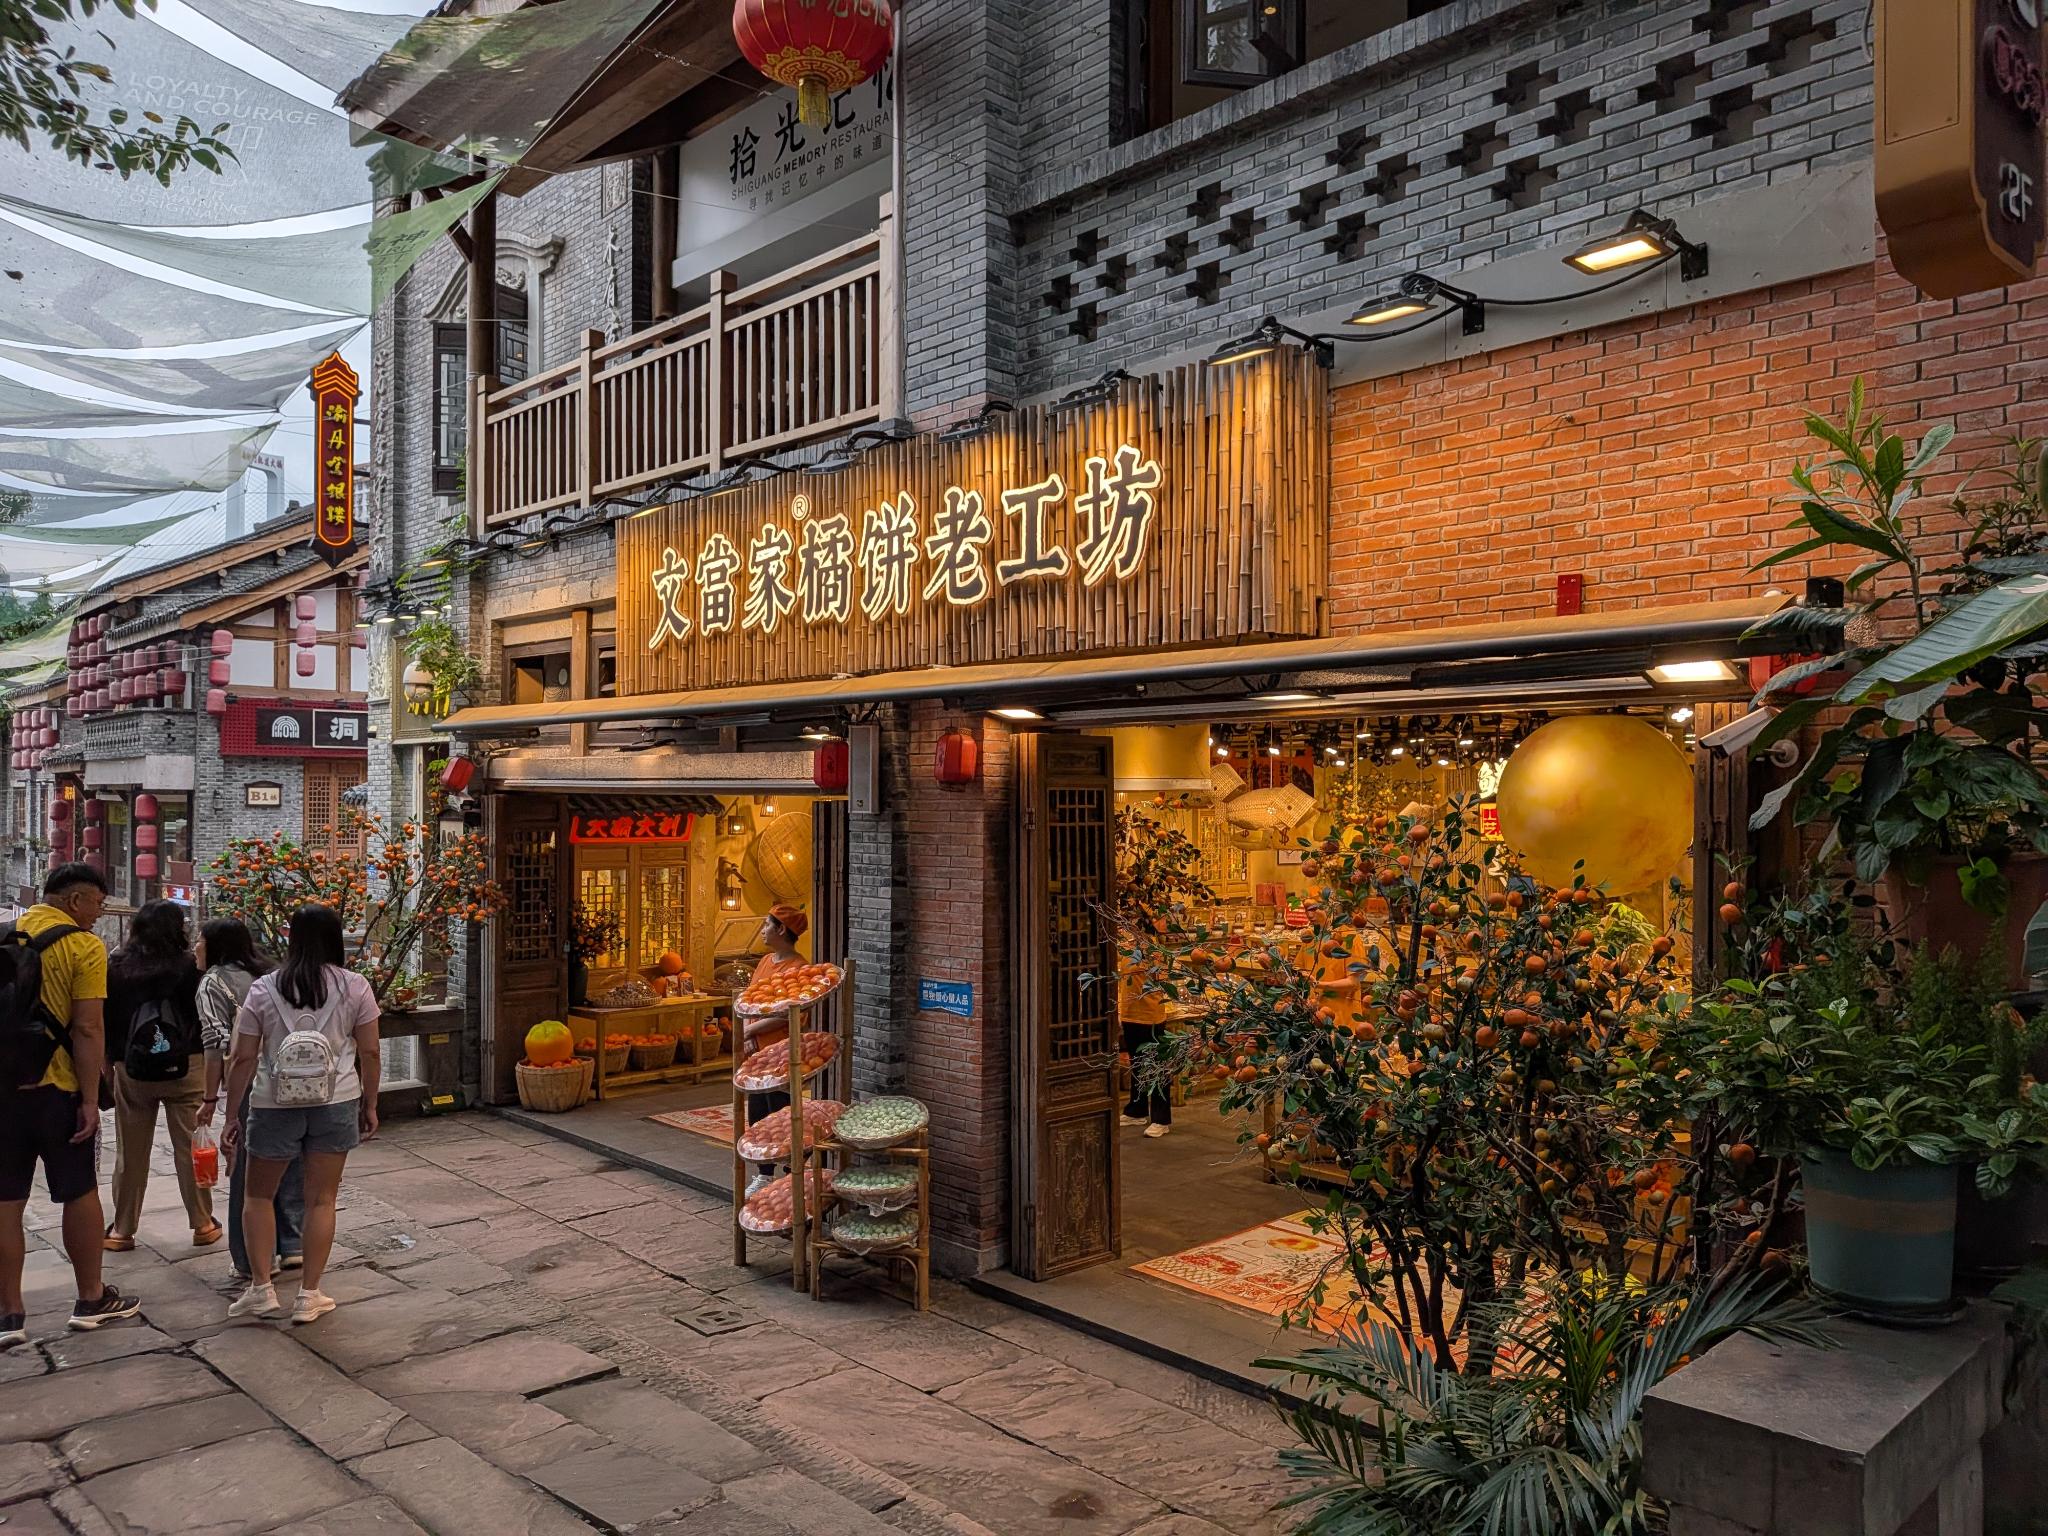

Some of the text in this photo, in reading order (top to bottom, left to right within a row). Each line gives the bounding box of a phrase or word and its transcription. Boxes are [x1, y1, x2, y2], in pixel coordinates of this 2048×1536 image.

[128, 72, 248, 101] LOYALTY
[123, 88, 320, 126] AND COURAGE
[731, 166, 782, 201] SHIGUANG
[783, 142, 828, 175] MEMORY
[329, 716, 359, 741] 洞
